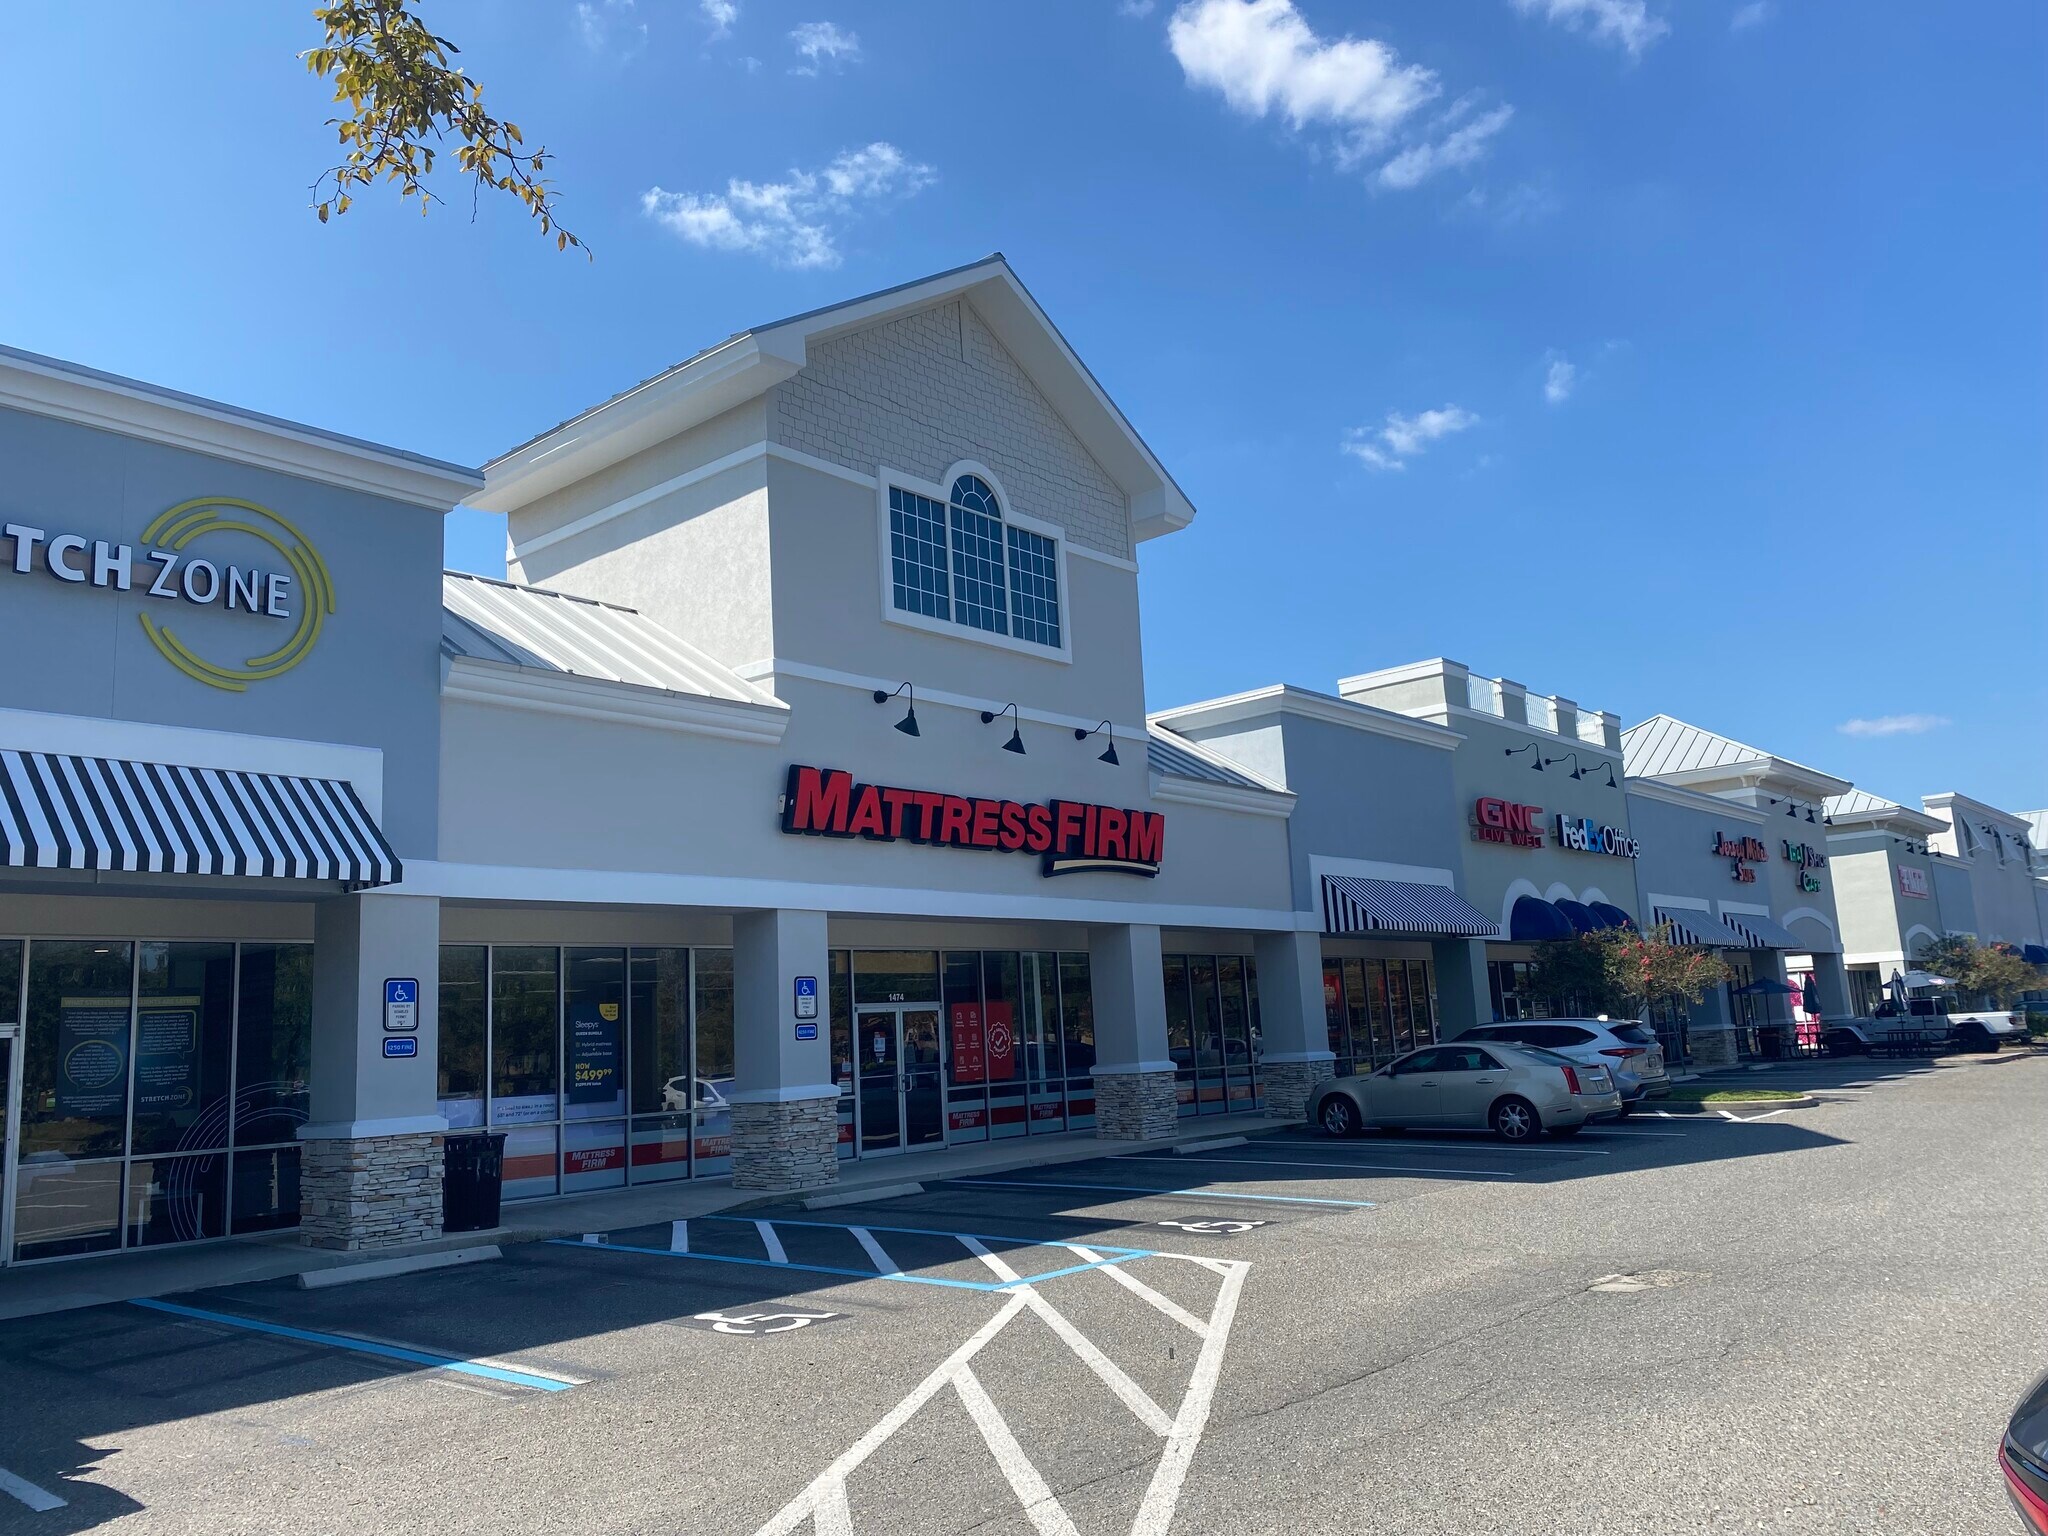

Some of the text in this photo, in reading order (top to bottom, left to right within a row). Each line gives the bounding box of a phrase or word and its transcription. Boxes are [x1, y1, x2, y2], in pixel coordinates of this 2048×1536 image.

[147, 550, 292, 618] ZONE
[786, 765, 1165, 863] MATTRESS FIRM
[1476, 796, 1545, 835] GNC
[1557, 814, 1641, 859] FedEx Office
[889, 993, 905, 1002] 1474
[140, 1093, 186, 1103] STRETCH ZONE
[952, 1110, 980, 1120] MATTRESS
[958, 1118, 975, 1128] FIRM
[701, 1137, 731, 1147] MATTRE
[571, 1149, 616, 1161] MATTRESS
[581, 1157, 607, 1169] FIRM
